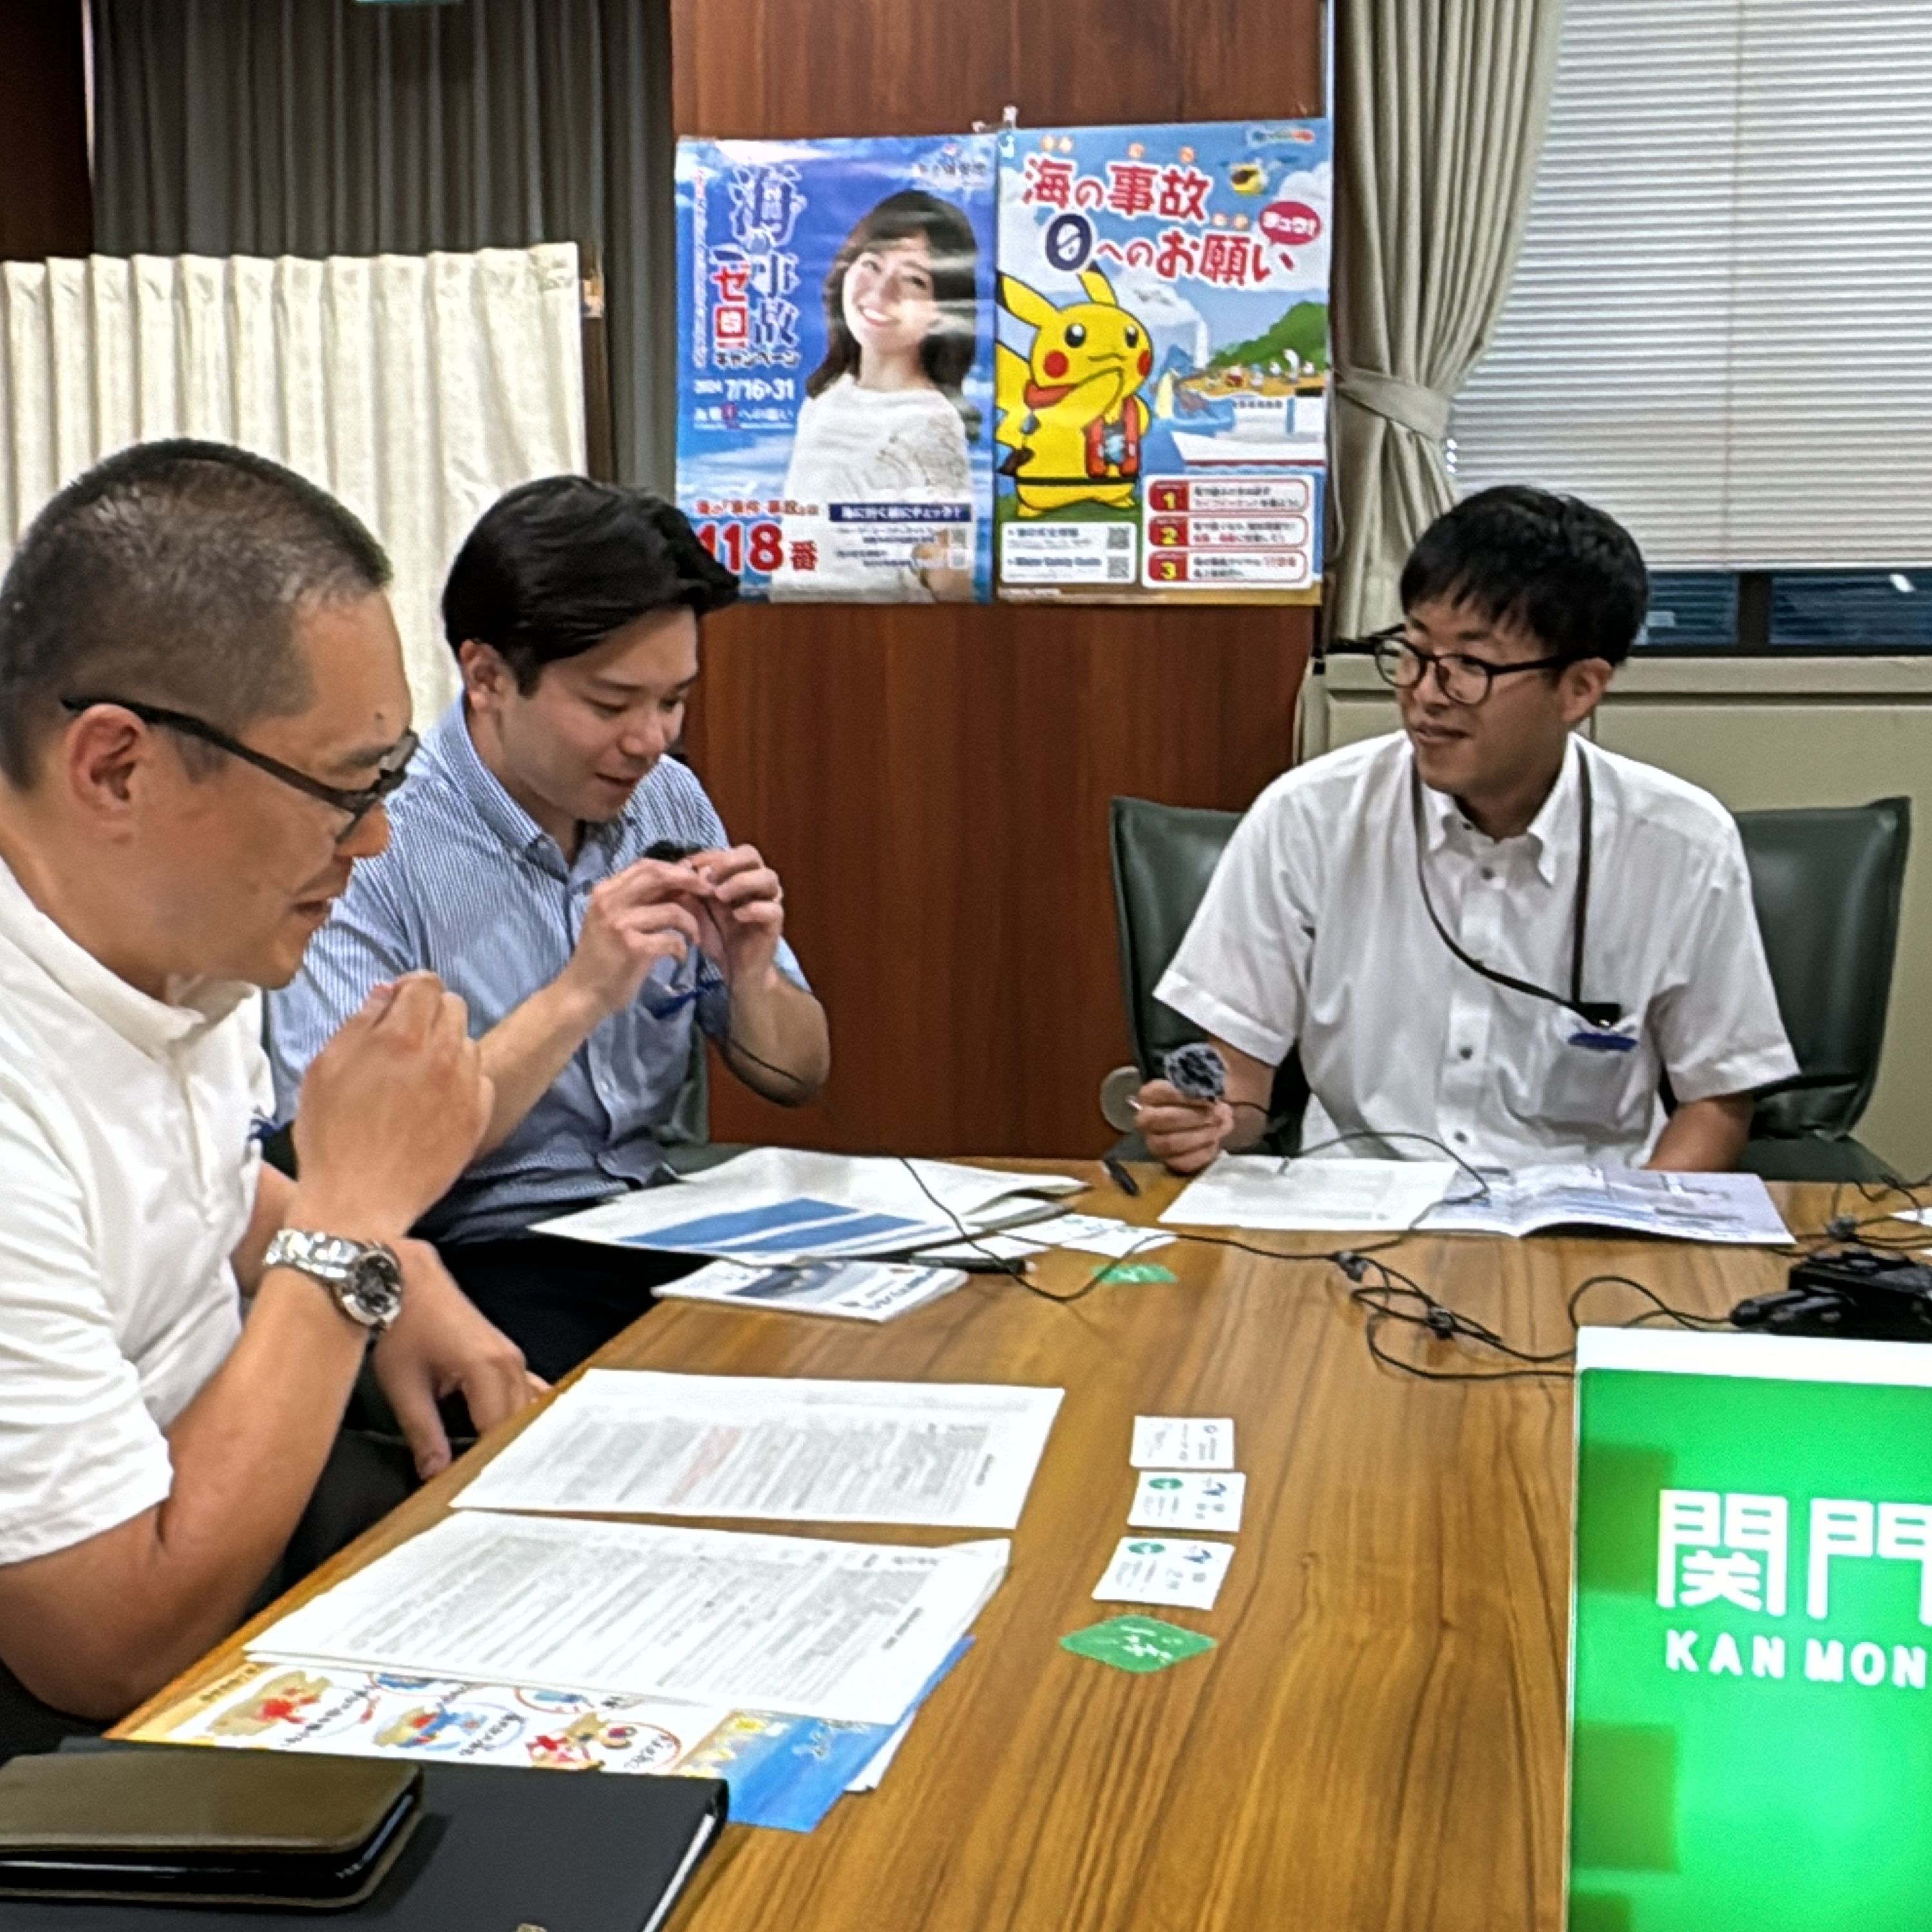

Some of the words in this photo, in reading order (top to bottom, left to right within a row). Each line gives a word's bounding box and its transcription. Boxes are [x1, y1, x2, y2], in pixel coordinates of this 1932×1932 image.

[1023, 158, 1211, 221] 海の事故
[1162, 491, 1175, 509] 1
[1160, 527, 1179, 545] 2
[1160, 560, 1177, 580] 3
[1656, 1489, 1932, 1626] 関門
